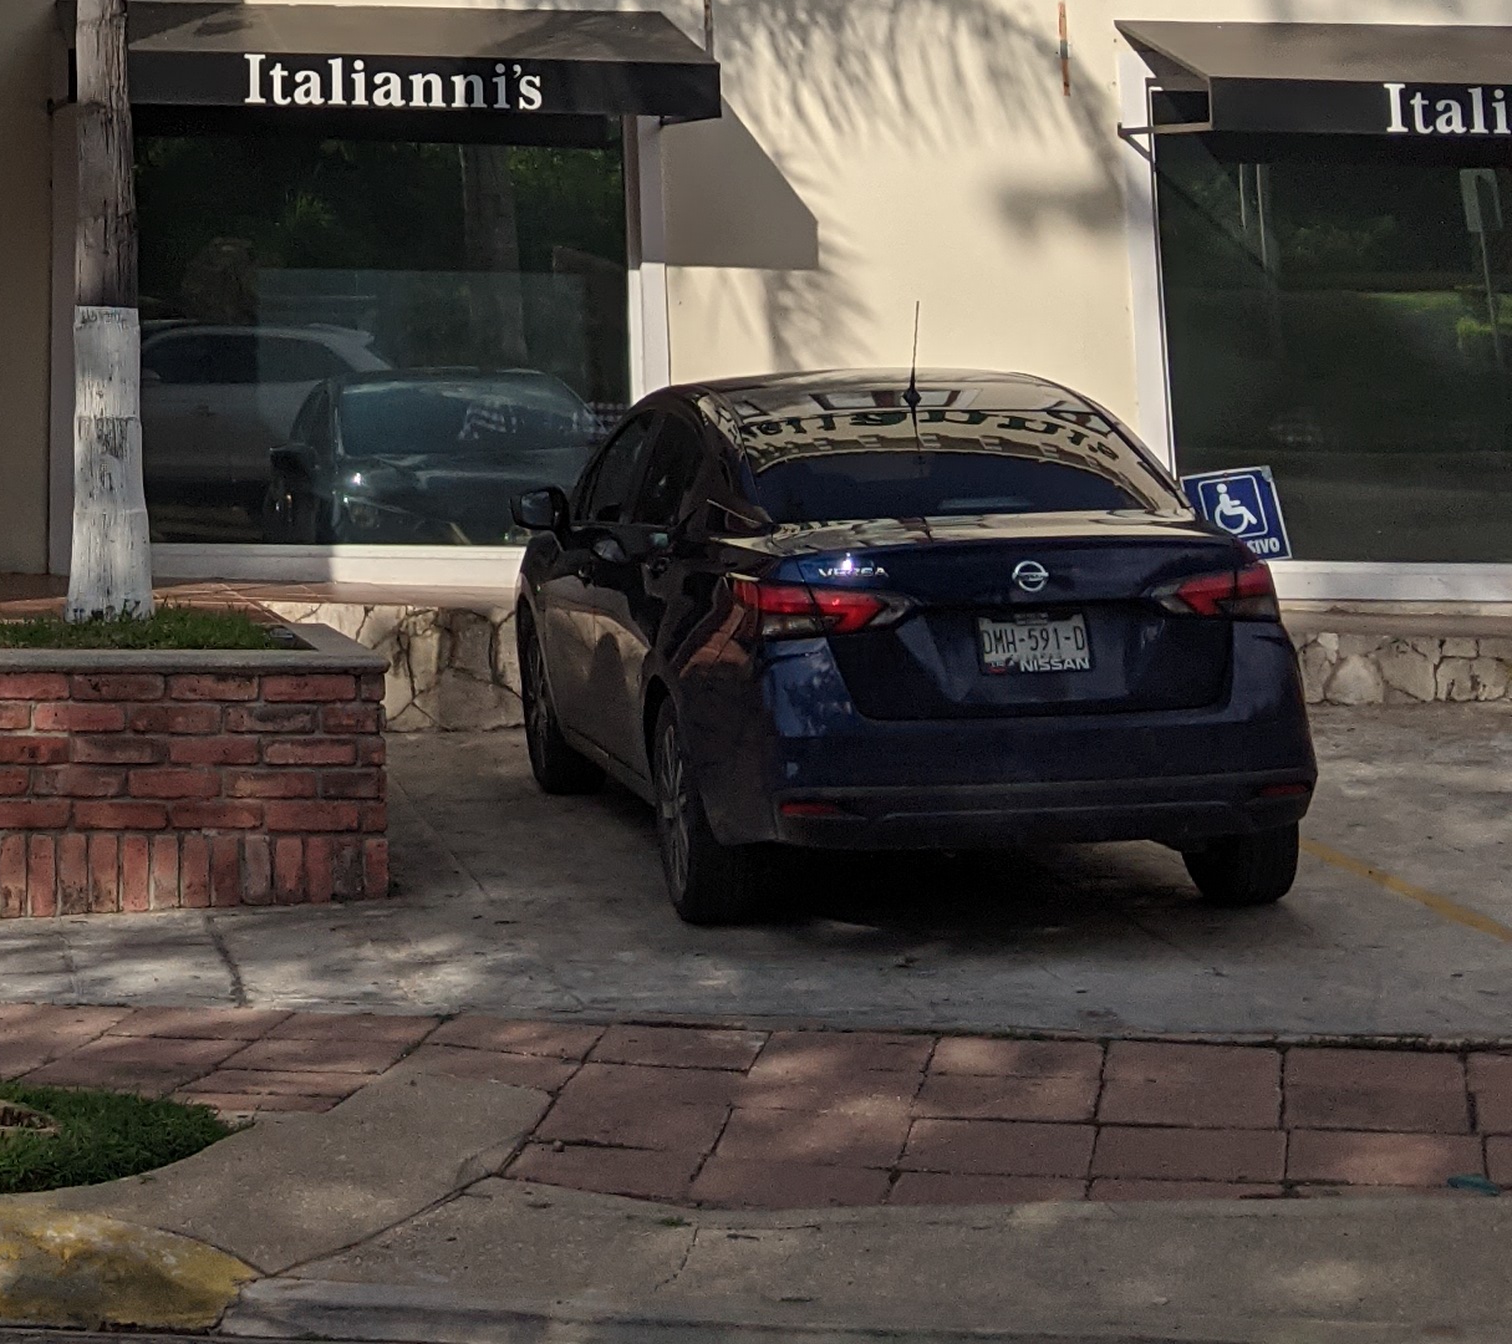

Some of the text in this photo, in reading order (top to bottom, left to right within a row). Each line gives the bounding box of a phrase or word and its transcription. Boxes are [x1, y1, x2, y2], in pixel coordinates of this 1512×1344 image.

[243, 53, 543, 110] Italianni's
[1383, 83, 1512, 135] Itali
[1020, 657, 1091, 673] NISSAN
